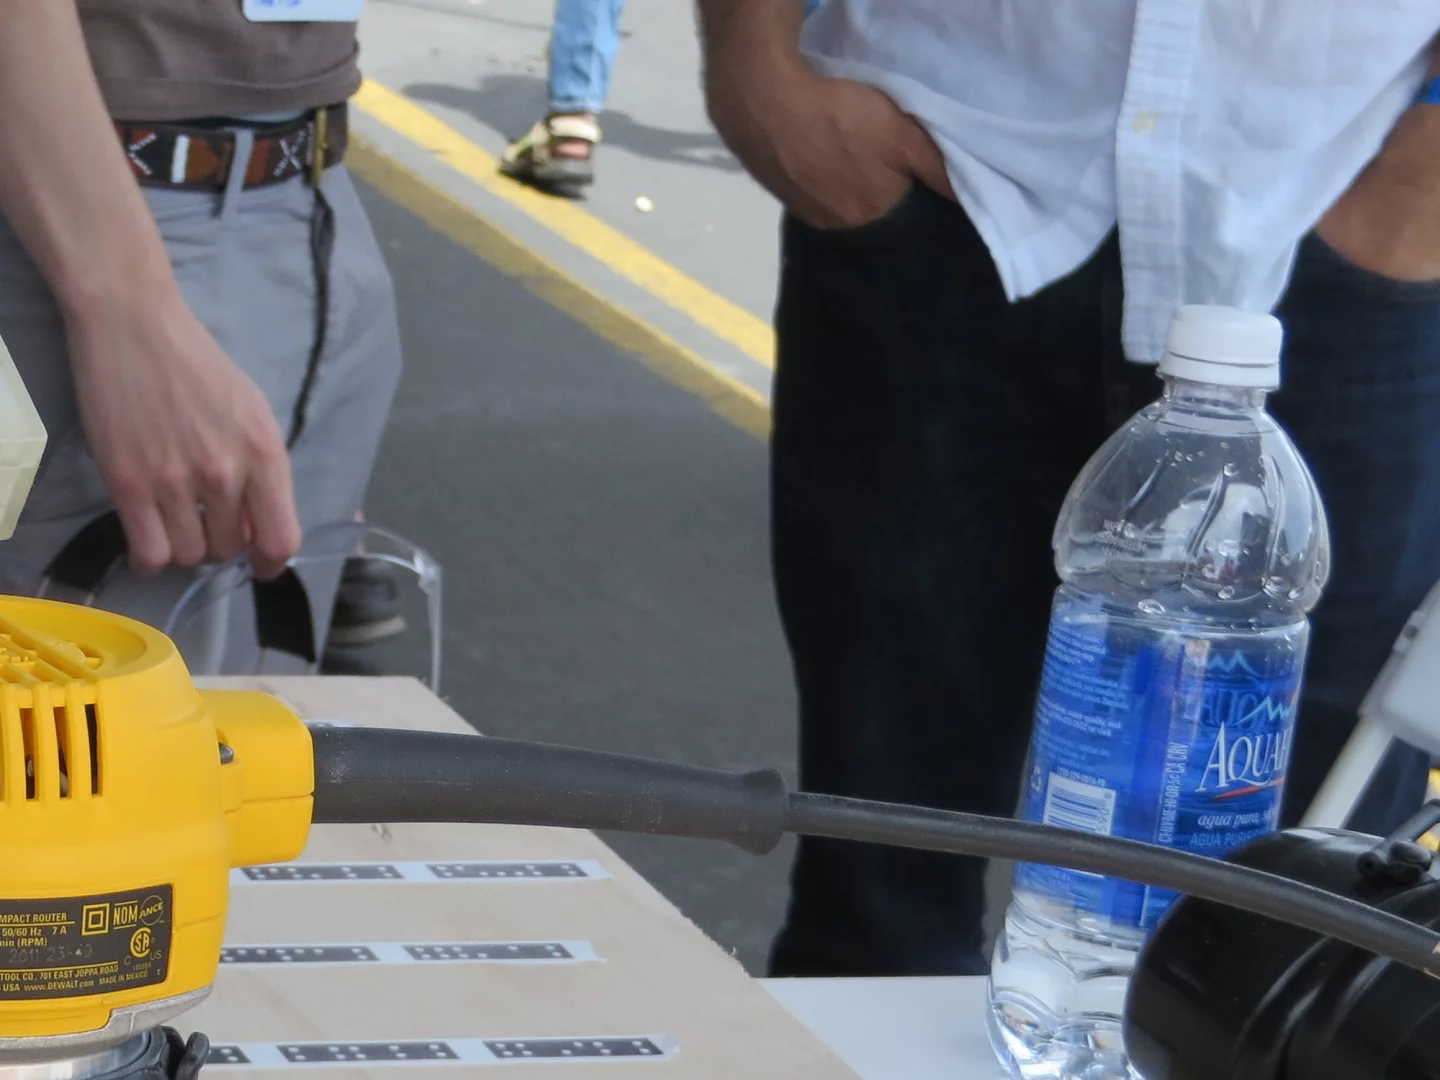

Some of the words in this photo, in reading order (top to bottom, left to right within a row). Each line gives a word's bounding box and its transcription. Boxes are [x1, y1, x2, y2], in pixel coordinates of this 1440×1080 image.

[1197, 814, 1231, 830] agua
[1189, 832, 1223, 849] AGUA
[32, 912, 68, 923] ROUTER
[139, 901, 164, 919] ANCE
[2, 926, 28, 937] 50/60
[30, 926, 43, 937] Hz
[52, 925, 59, 936] 7
[60, 925, 68, 935] A
[16, 937, 48, 948] (RPM)
[149, 949, 163, 961] US
[0, 972, 20, 981] TOOL
[40, 971, 52, 980] 701
[53, 970, 73, 980] EAST
[74, 967, 99, 978] JOPPA
[100, 964, 119, 975] ROAD
[3, 983, 21, 992] USA
[23, 979, 95, 991] www.DEWALT.com
[98, 975, 117, 985] MADE
[126, 970, 149, 981] MEXICO
